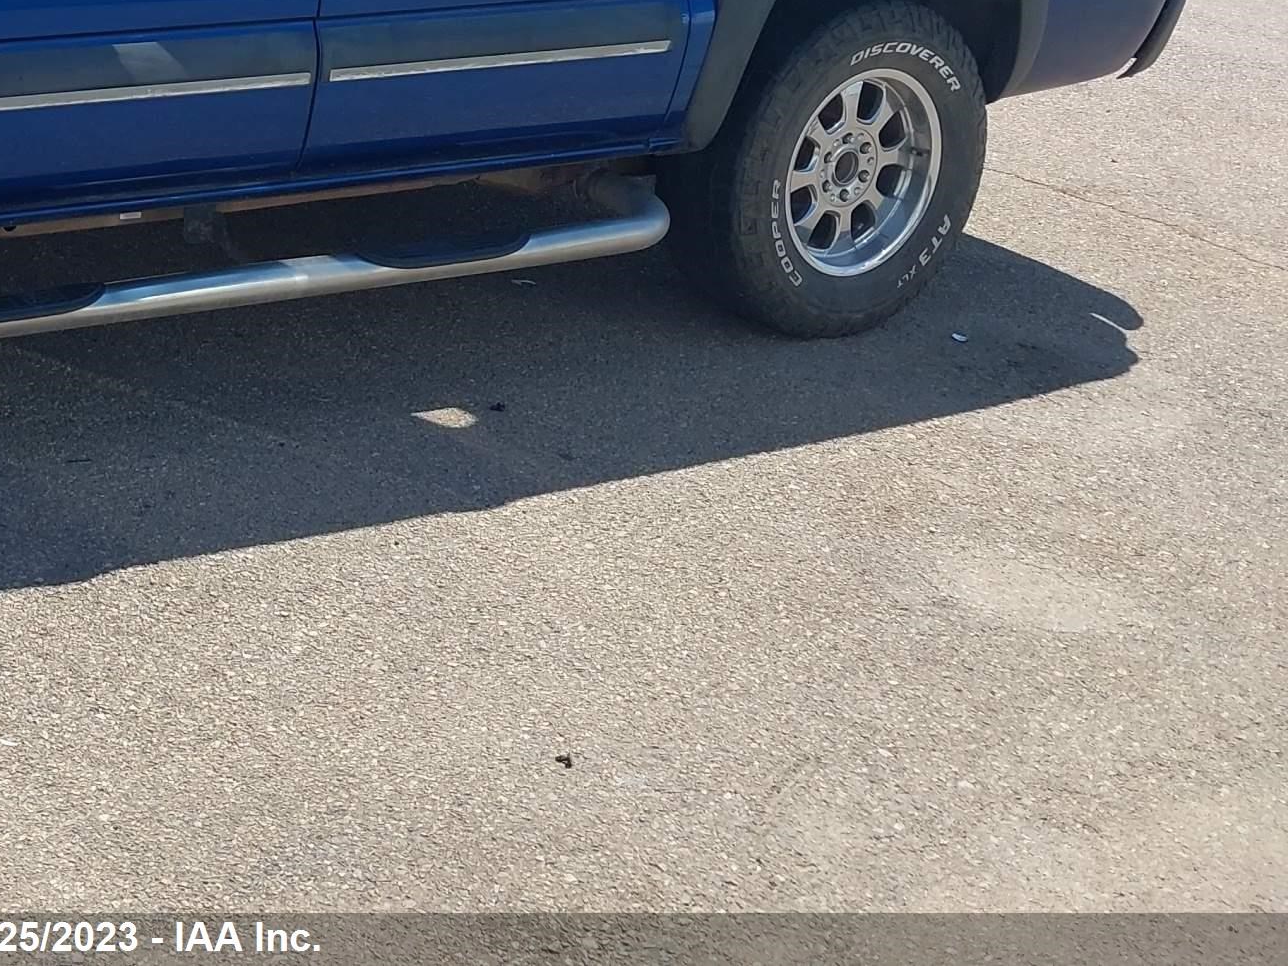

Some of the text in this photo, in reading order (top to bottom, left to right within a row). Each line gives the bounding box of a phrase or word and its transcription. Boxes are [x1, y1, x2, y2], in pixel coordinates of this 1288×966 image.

[771, 41, 961, 289] COOPER DISCOVERER AT3 XLT
